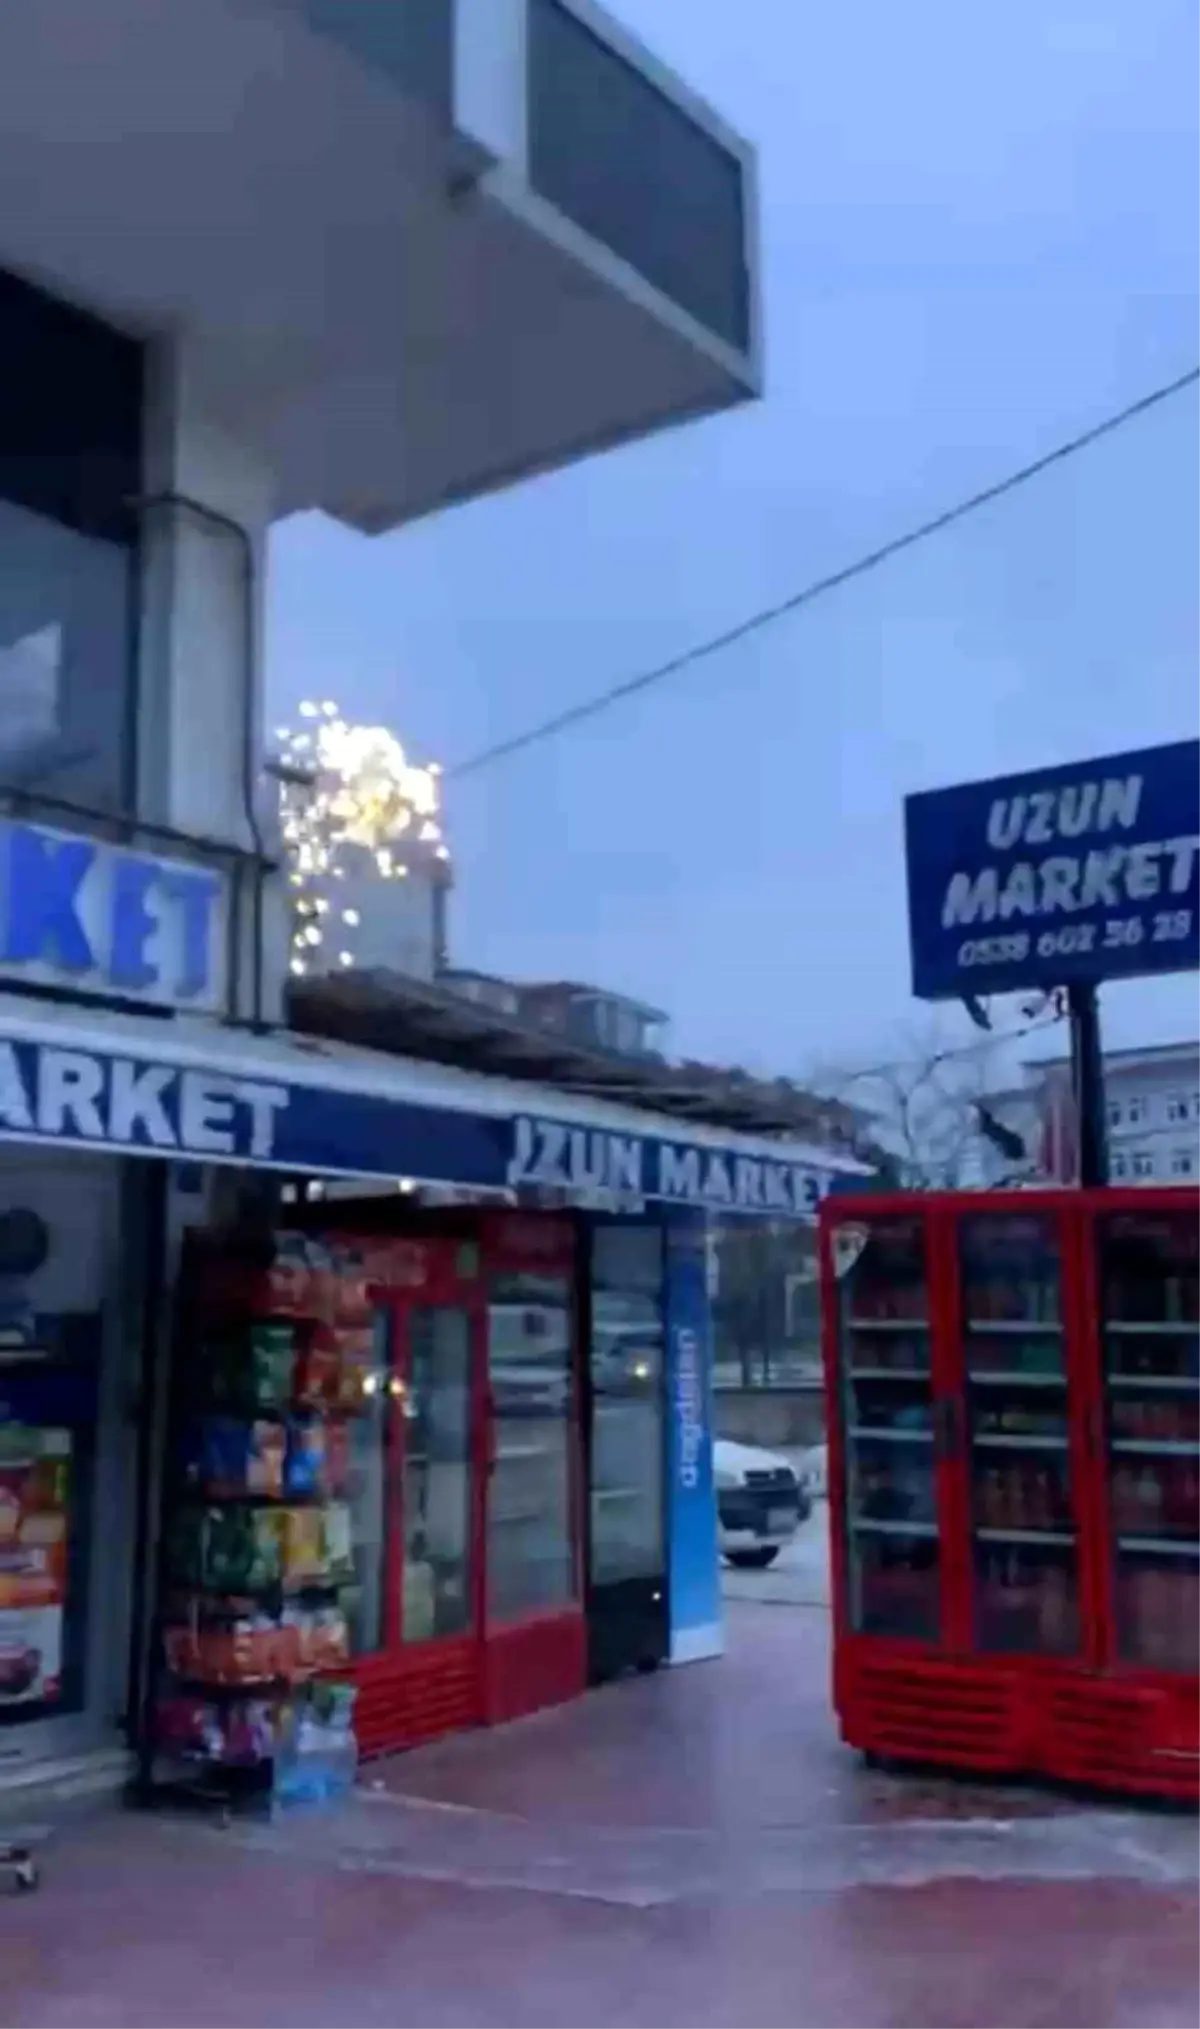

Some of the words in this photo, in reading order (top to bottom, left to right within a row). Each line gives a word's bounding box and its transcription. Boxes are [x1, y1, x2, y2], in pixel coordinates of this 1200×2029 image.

[987, 774, 1143, 849] UZUN
[942, 834, 1200, 929] MARKET
[659, 1145, 834, 1211] MARKET
